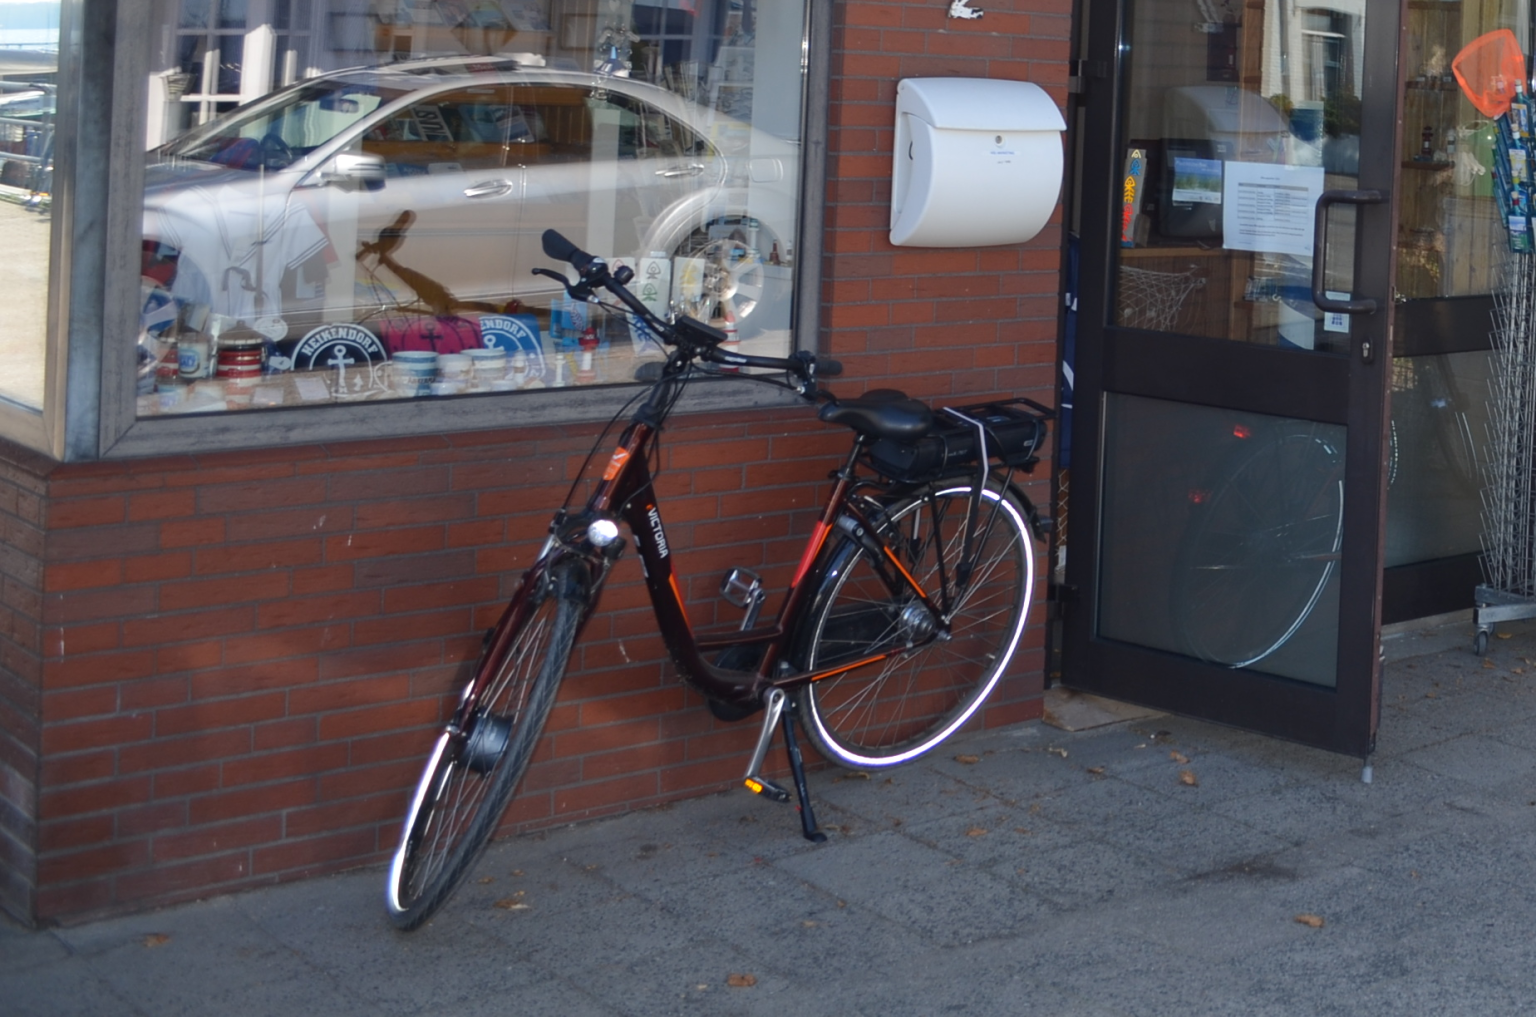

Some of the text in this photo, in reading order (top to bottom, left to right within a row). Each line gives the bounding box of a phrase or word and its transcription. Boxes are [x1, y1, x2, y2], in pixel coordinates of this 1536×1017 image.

[301, 327, 378, 356] HEIKENDORF
[479, 318, 526, 339] ENDORF
[647, 507, 669, 559] VICTORIA
